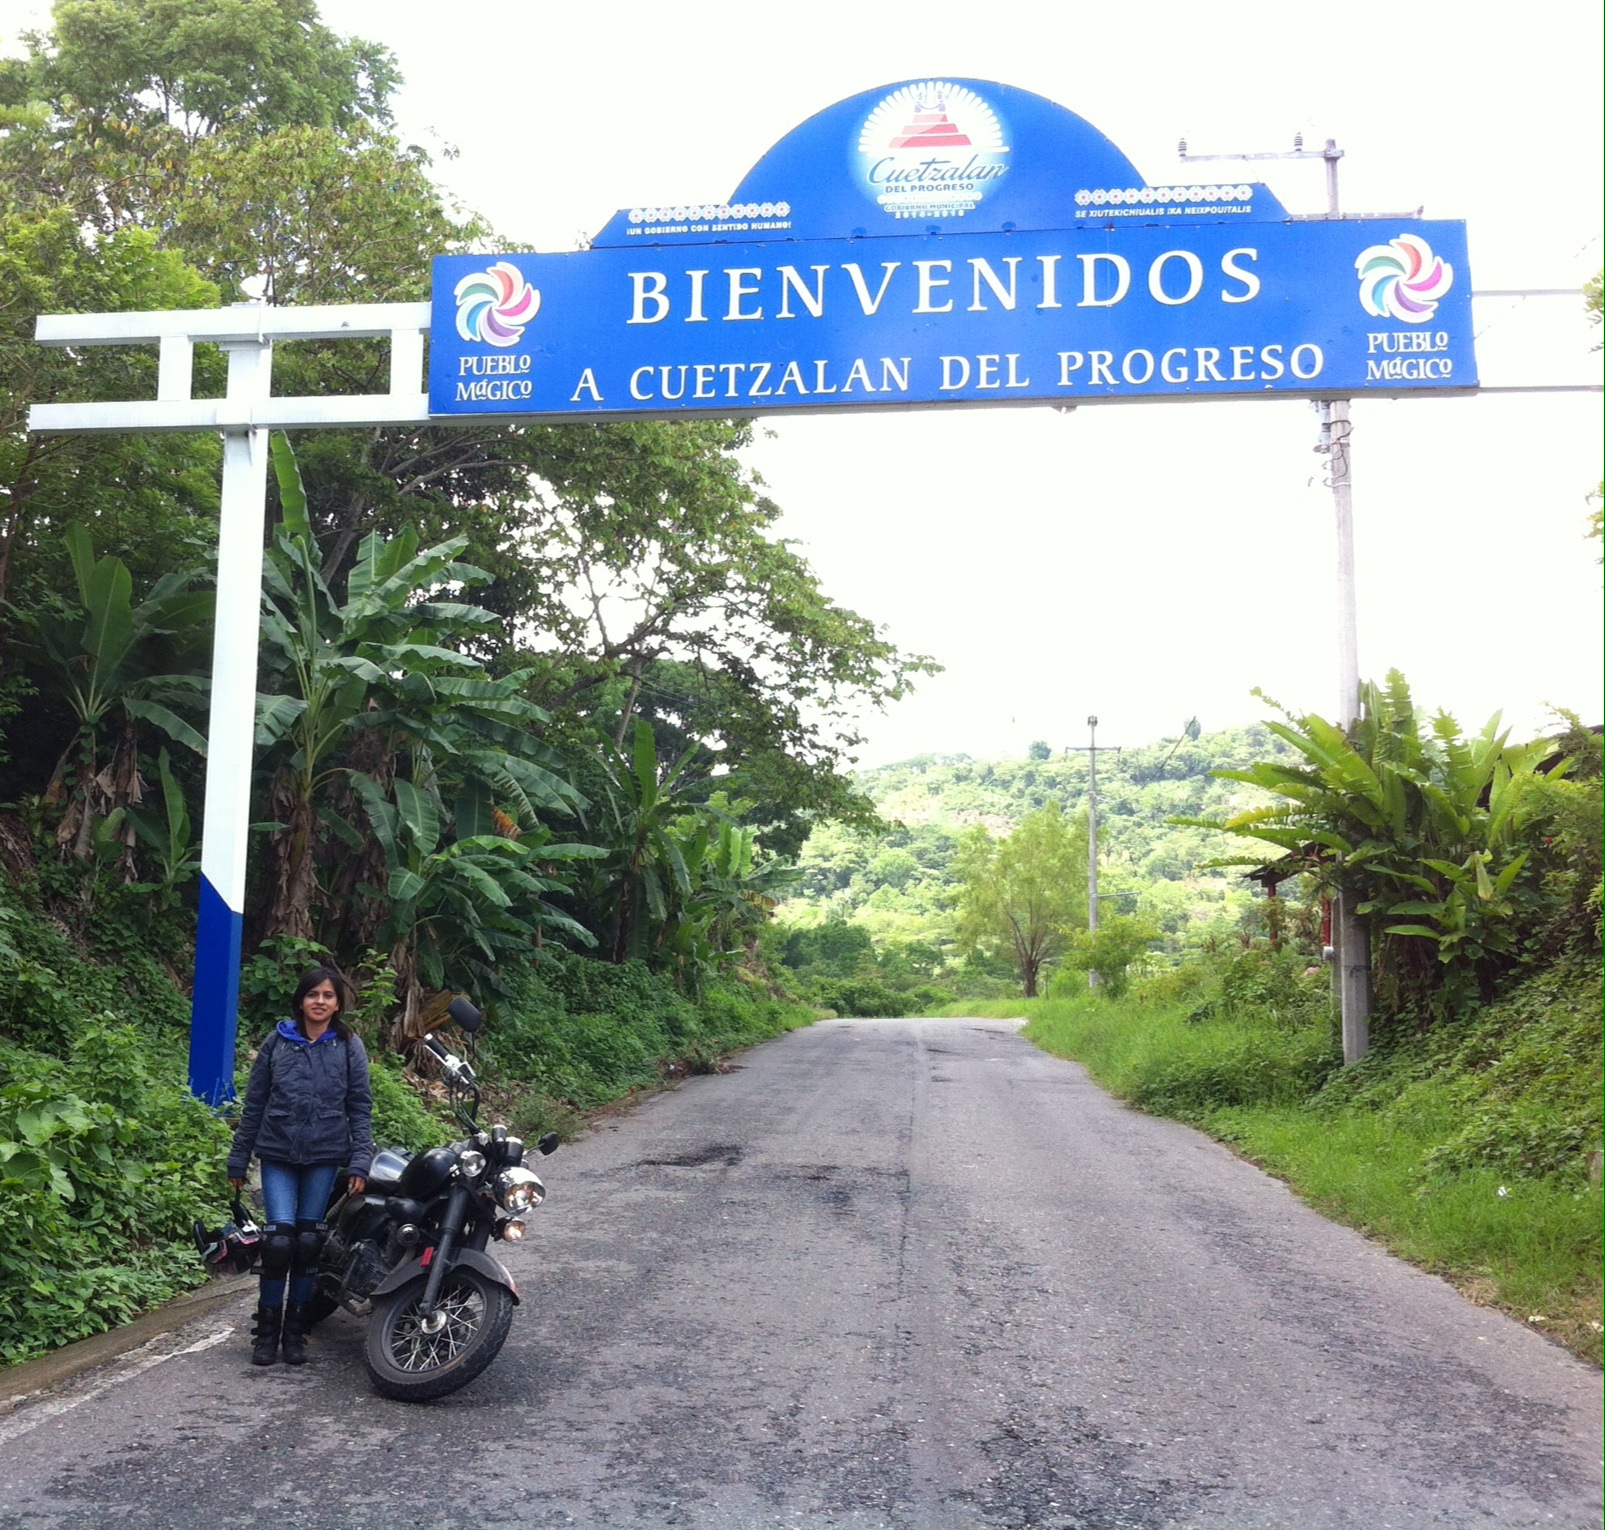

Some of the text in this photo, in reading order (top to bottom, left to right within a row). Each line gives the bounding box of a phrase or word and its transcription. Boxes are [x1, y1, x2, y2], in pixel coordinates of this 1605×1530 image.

[868, 153, 1008, 184] Cuetzalan
[885, 183, 974, 193] DEL PROGRESO
[1075, 210, 1087, 218] SE
[644, 226, 689, 235] GOBIERNO
[691, 225, 709, 233] CON
[711, 223, 748, 232] SENTIDO
[751, 221, 792, 230] HUMANO!
[627, 248, 1260, 323] BIENVENIDOS
[571, 344, 1323, 400] A CUETZALAN DEL PROGRESO
